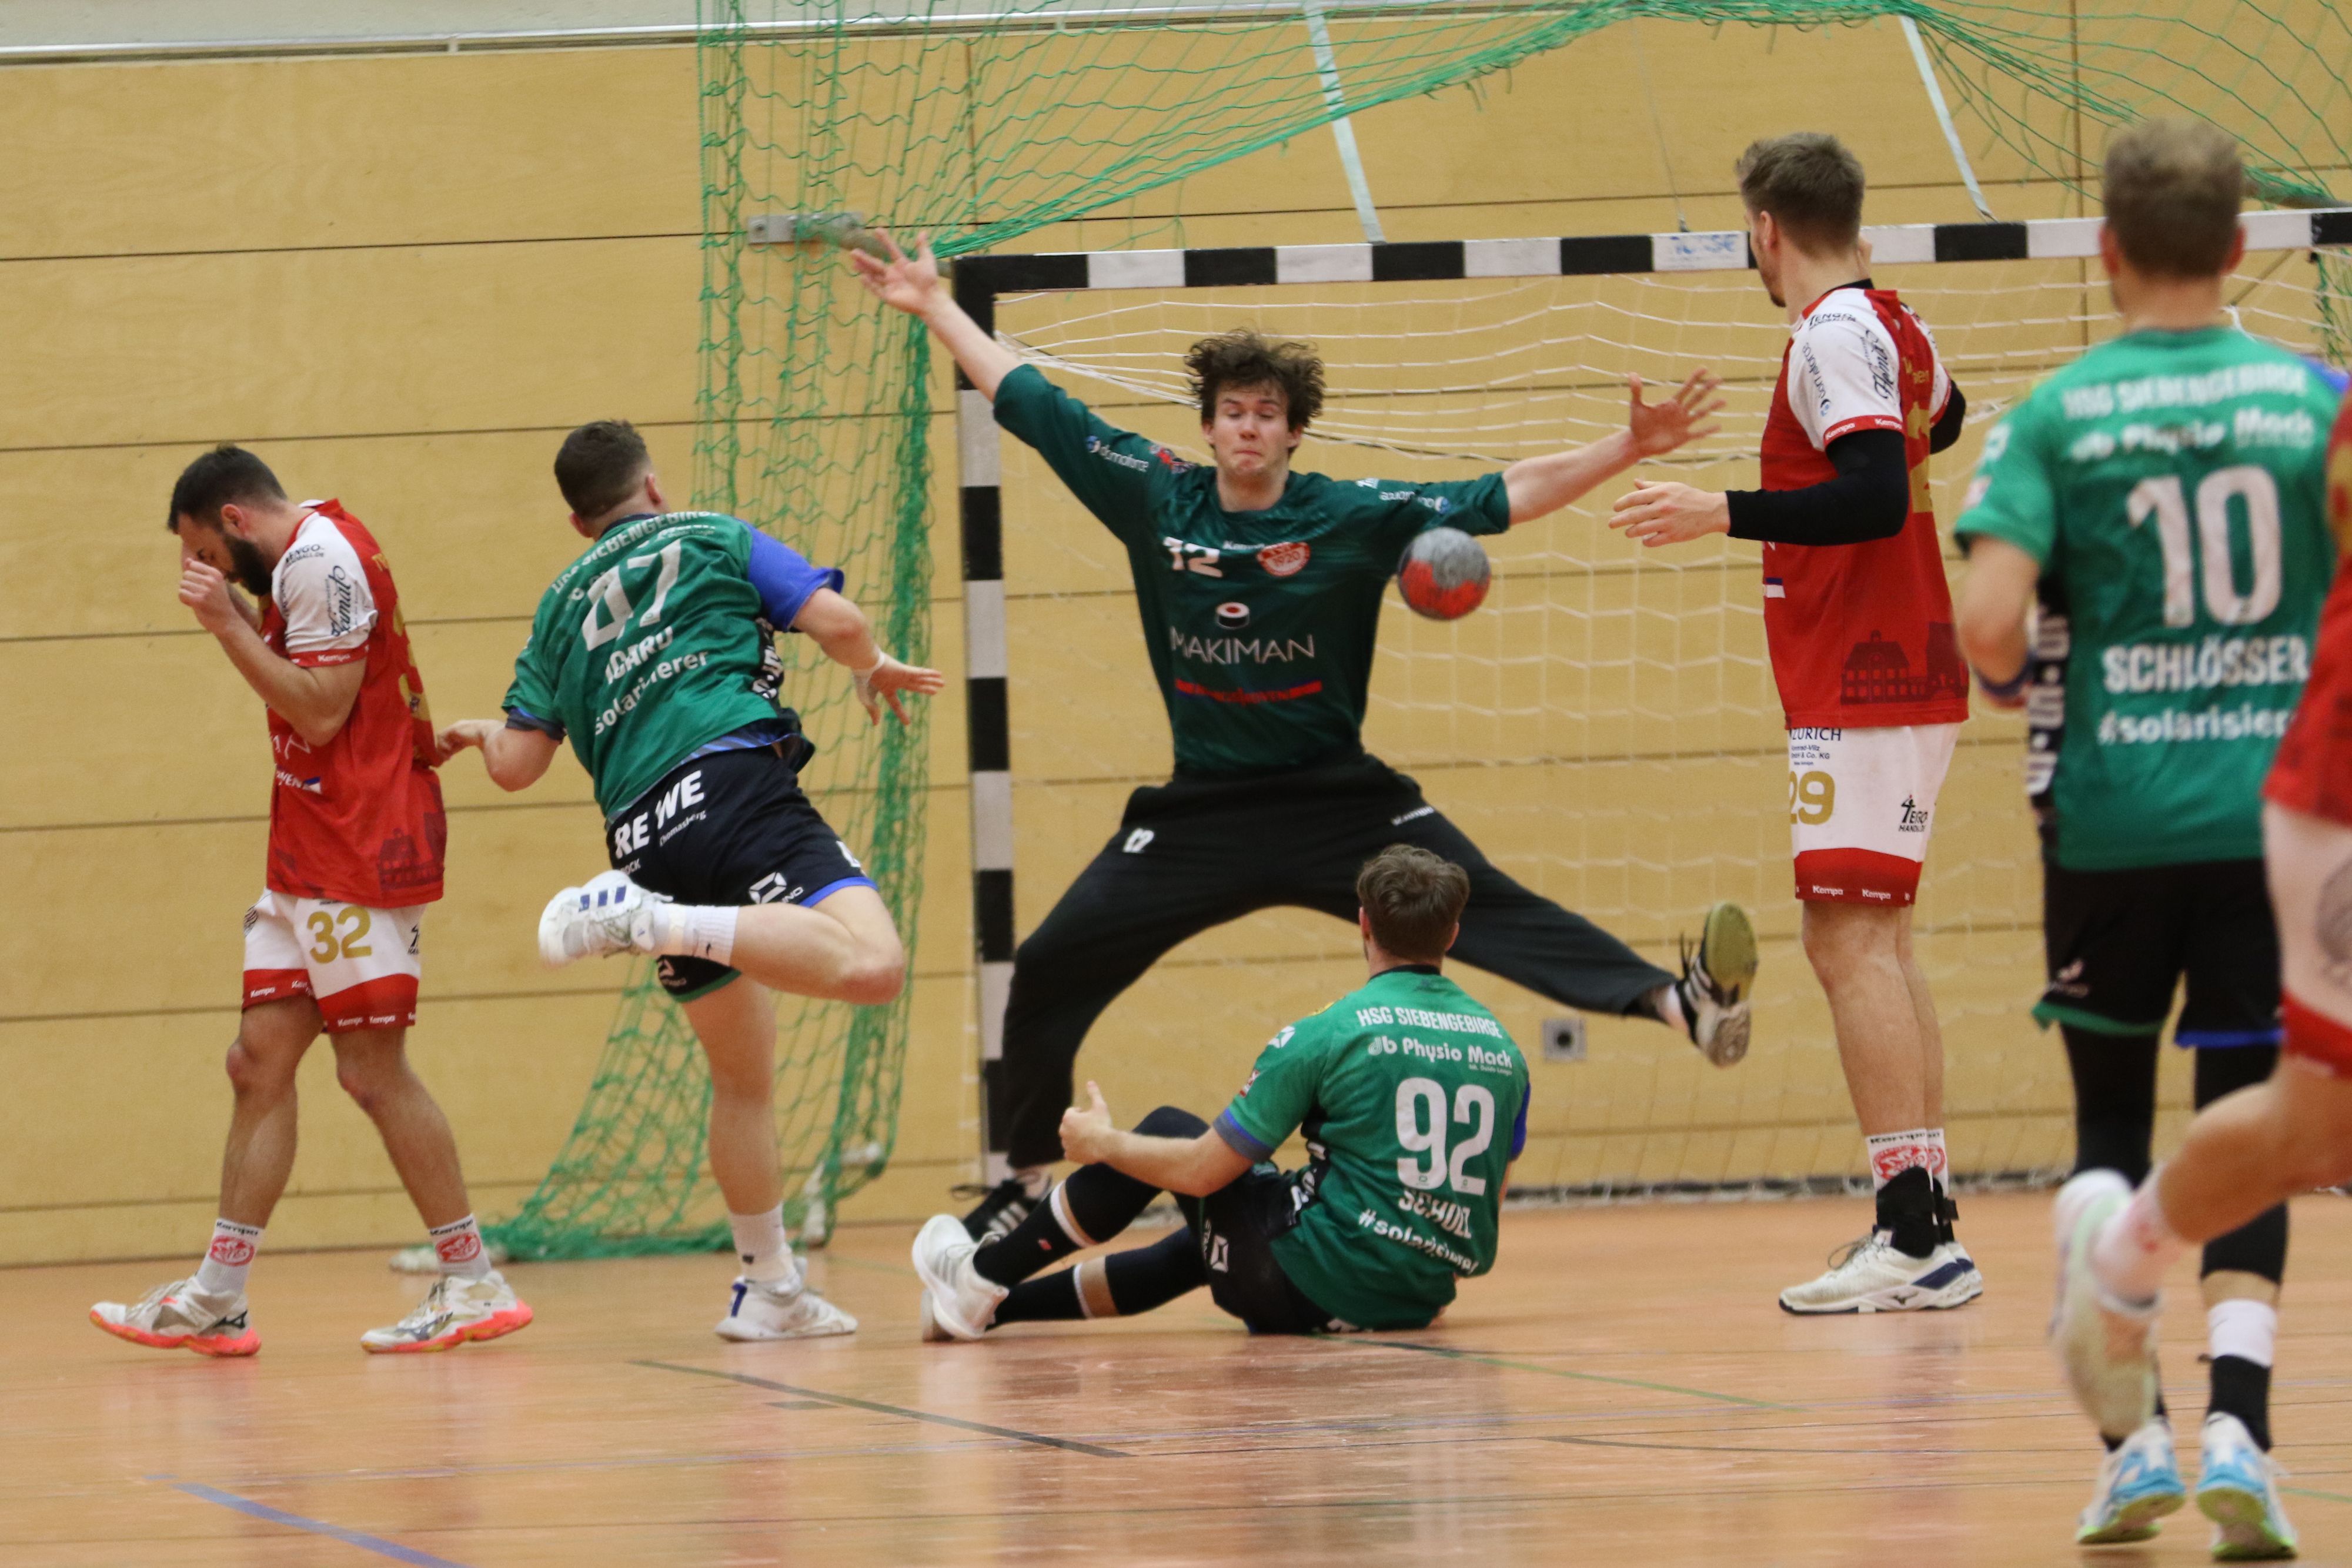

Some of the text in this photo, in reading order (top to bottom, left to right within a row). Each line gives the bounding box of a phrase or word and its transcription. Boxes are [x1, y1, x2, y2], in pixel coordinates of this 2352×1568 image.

[1825, 423, 1855, 441] Kempa
[1163, 536, 1224, 578] 12
[2127, 464, 2282, 627] 10
[582, 537, 681, 651] 47
[1169, 626, 1315, 665] MAKIMAN
[2102, 634, 2309, 694] SCHLÖSSER
[2097, 702, 2291, 745] #solarisier
[1813, 885, 1892, 901] Kempa Kempa
[306, 905, 373, 964] 32
[1356, 1006, 1504, 1039] HSG SIEBENGEBIRGE
[1401, 1037, 1462, 1064] Physio
[1468, 1044, 1514, 1069] Mack
[1395, 1077, 1495, 1196] 92
